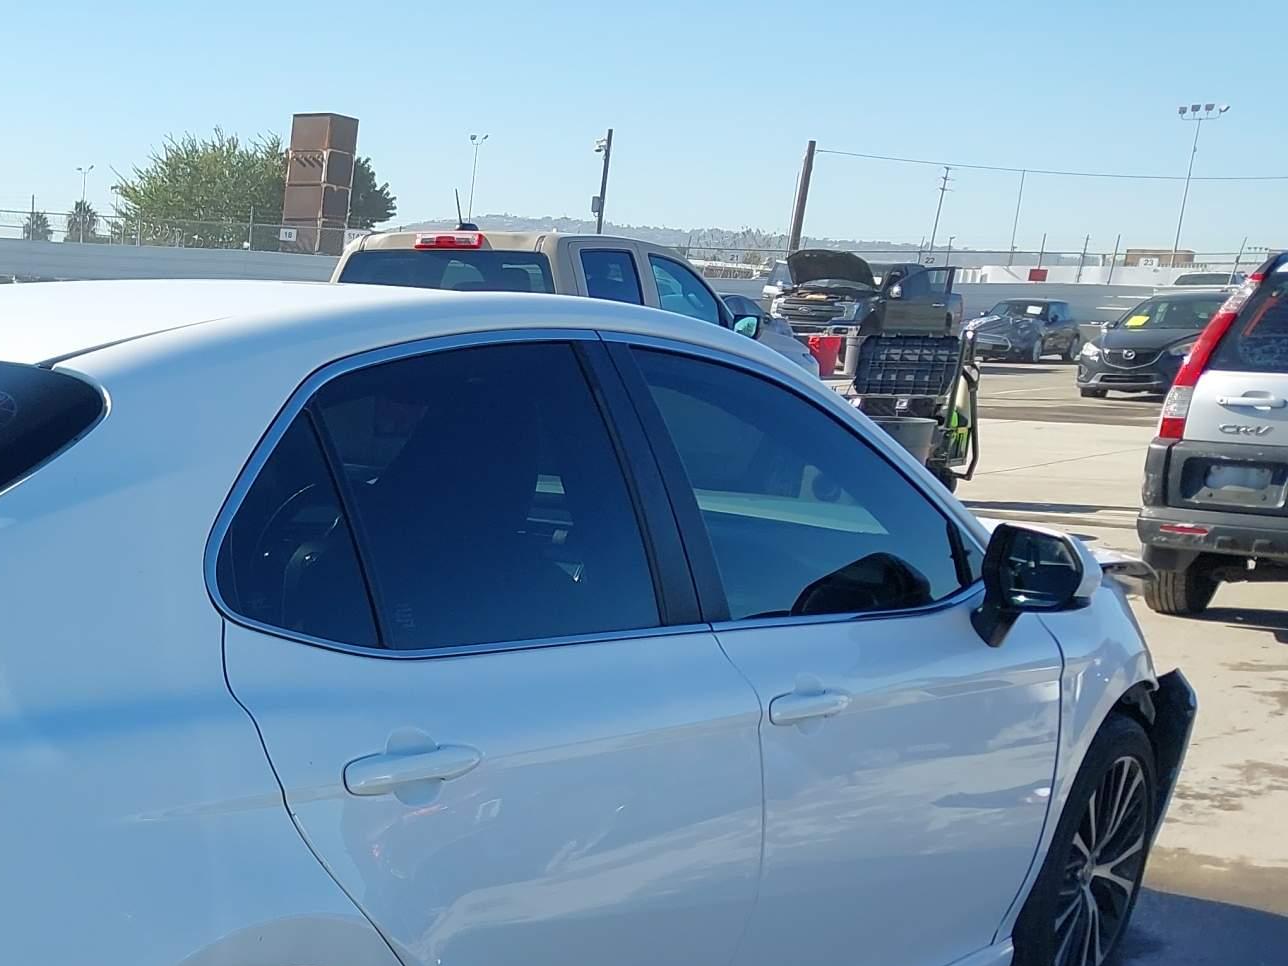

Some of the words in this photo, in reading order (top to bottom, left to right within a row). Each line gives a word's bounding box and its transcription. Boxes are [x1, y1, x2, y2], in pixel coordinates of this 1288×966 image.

[284, 231, 292, 239] 18
[925, 256, 936, 264] 22
[1143, 258, 1154, 266] 23
[1218, 424, 1274, 437] CR-V
